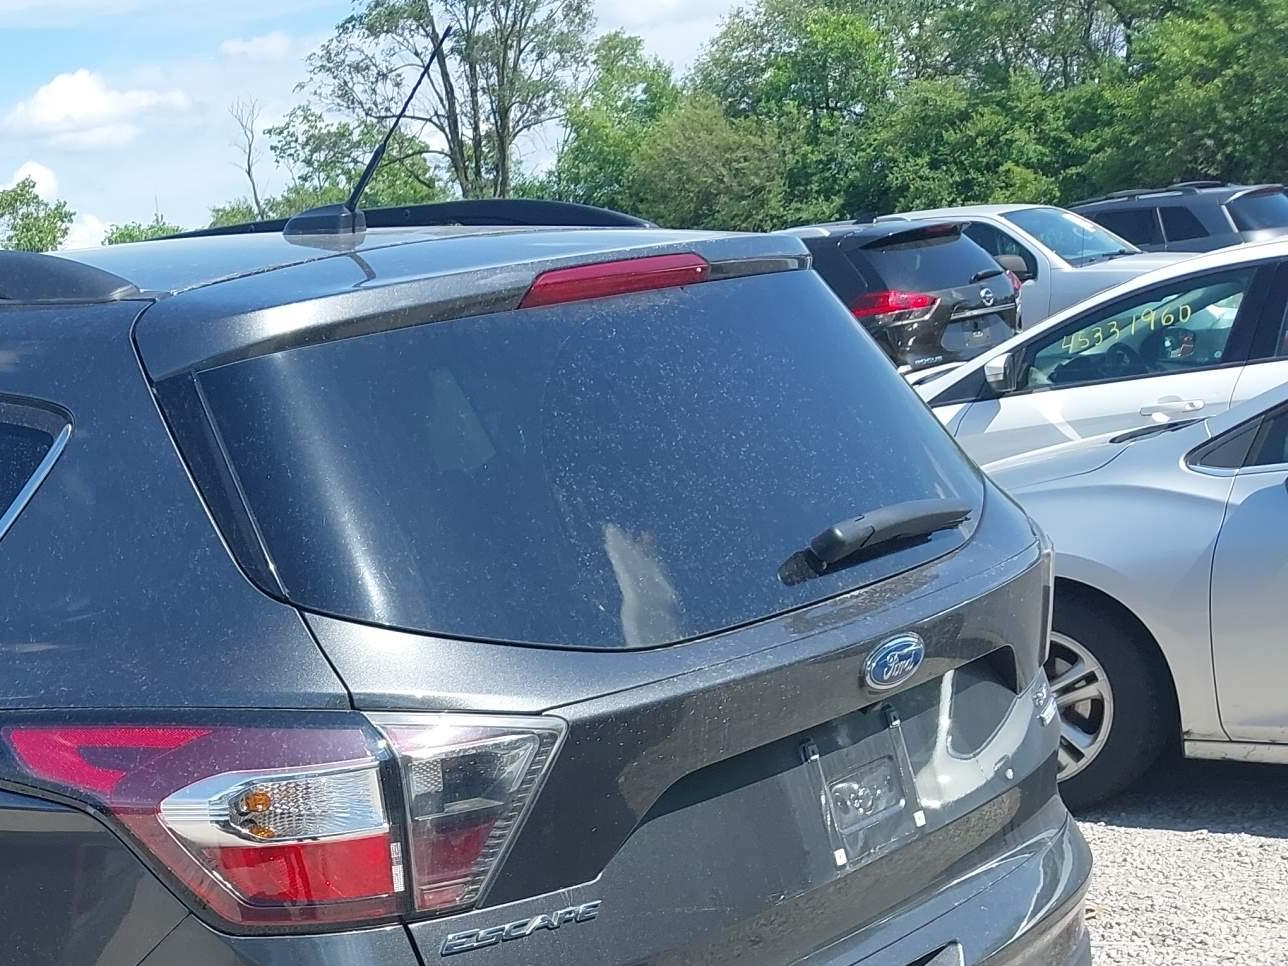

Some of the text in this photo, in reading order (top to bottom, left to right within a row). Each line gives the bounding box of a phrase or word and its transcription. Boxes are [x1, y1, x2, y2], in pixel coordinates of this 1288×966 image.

[1060, 304, 1191, 354] 45331960
[875, 636, 922, 682] Ford
[439, 899, 603, 957] ESCAPE
